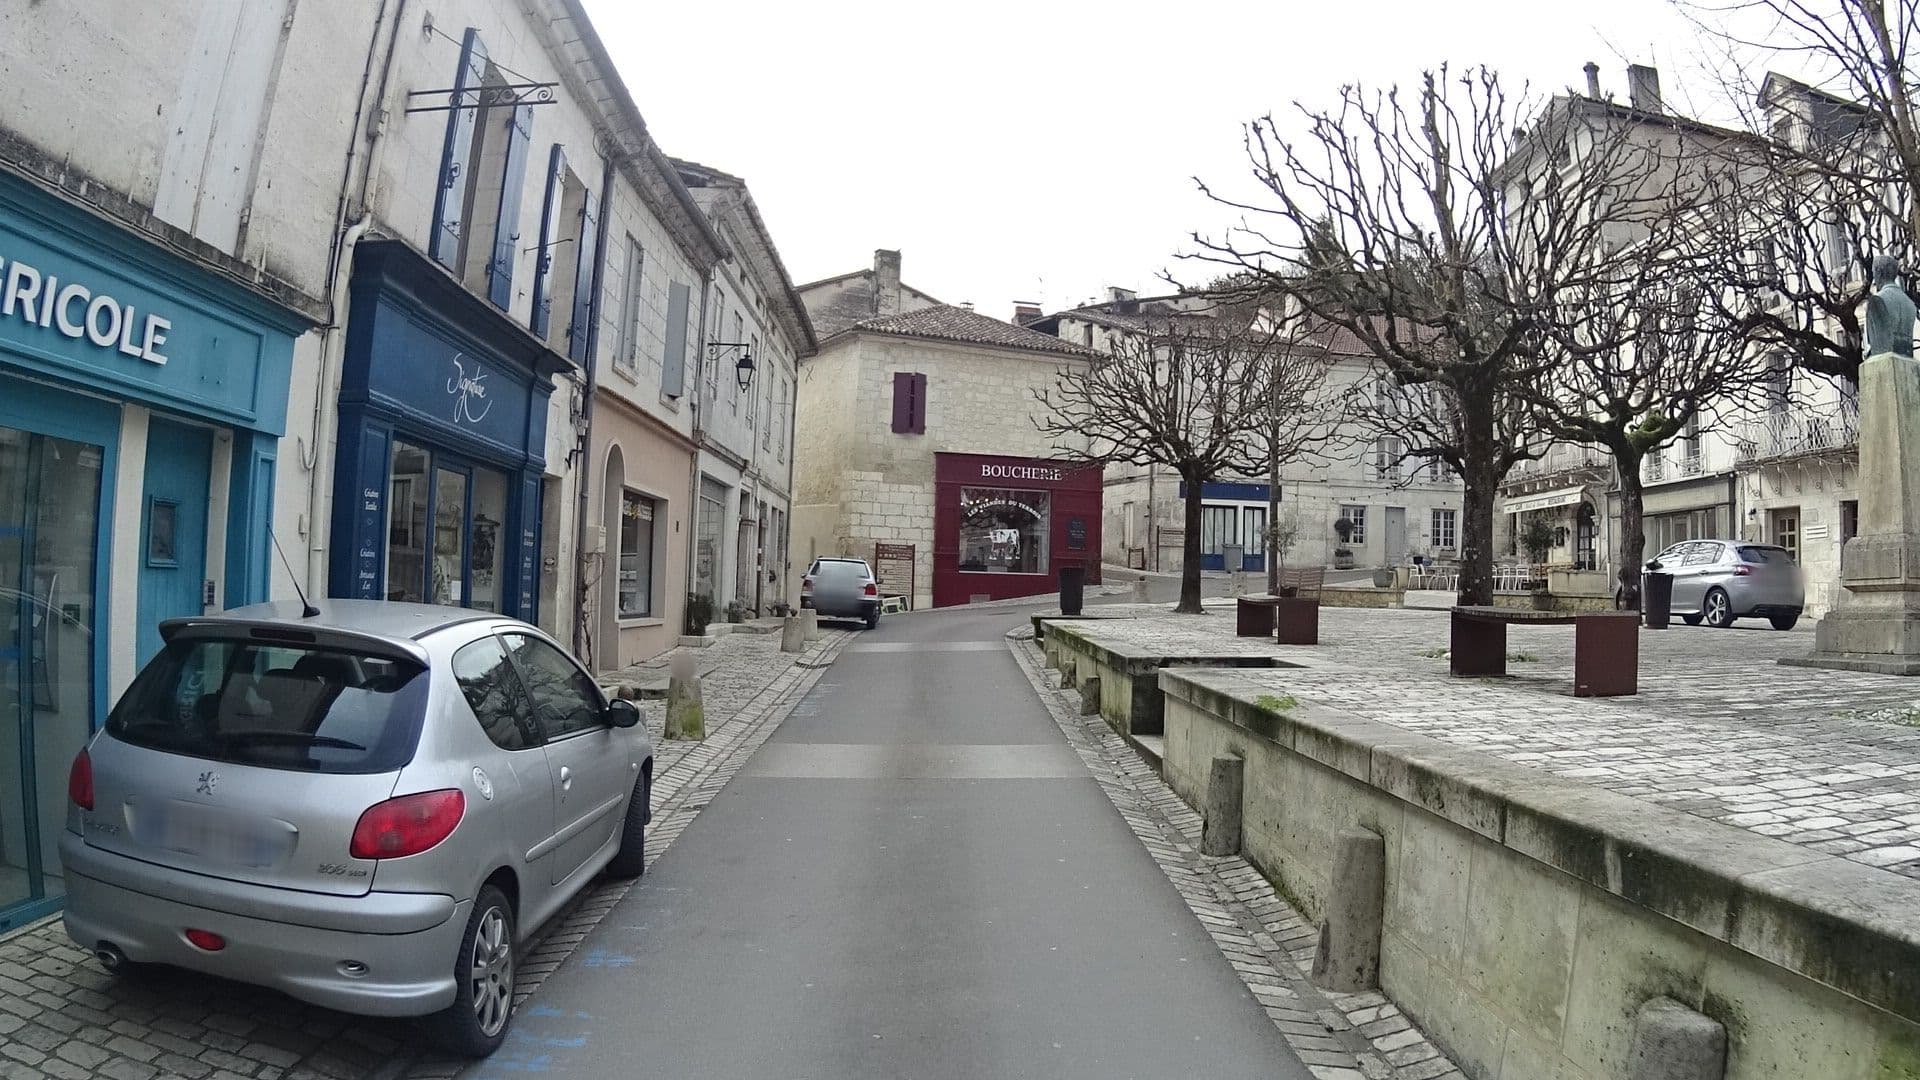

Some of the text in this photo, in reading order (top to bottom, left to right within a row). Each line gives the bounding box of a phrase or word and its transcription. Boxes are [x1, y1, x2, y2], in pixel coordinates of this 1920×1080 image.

[0, 255, 172, 366] RICOLE
[447, 352, 493, 423] Signature
[981, 464, 1063, 481] BOUCHERIE
[1008, 499, 1018, 507] DU
[1018, 502, 1042, 520] TERROIR
[318, 863, 348, 876] 206
